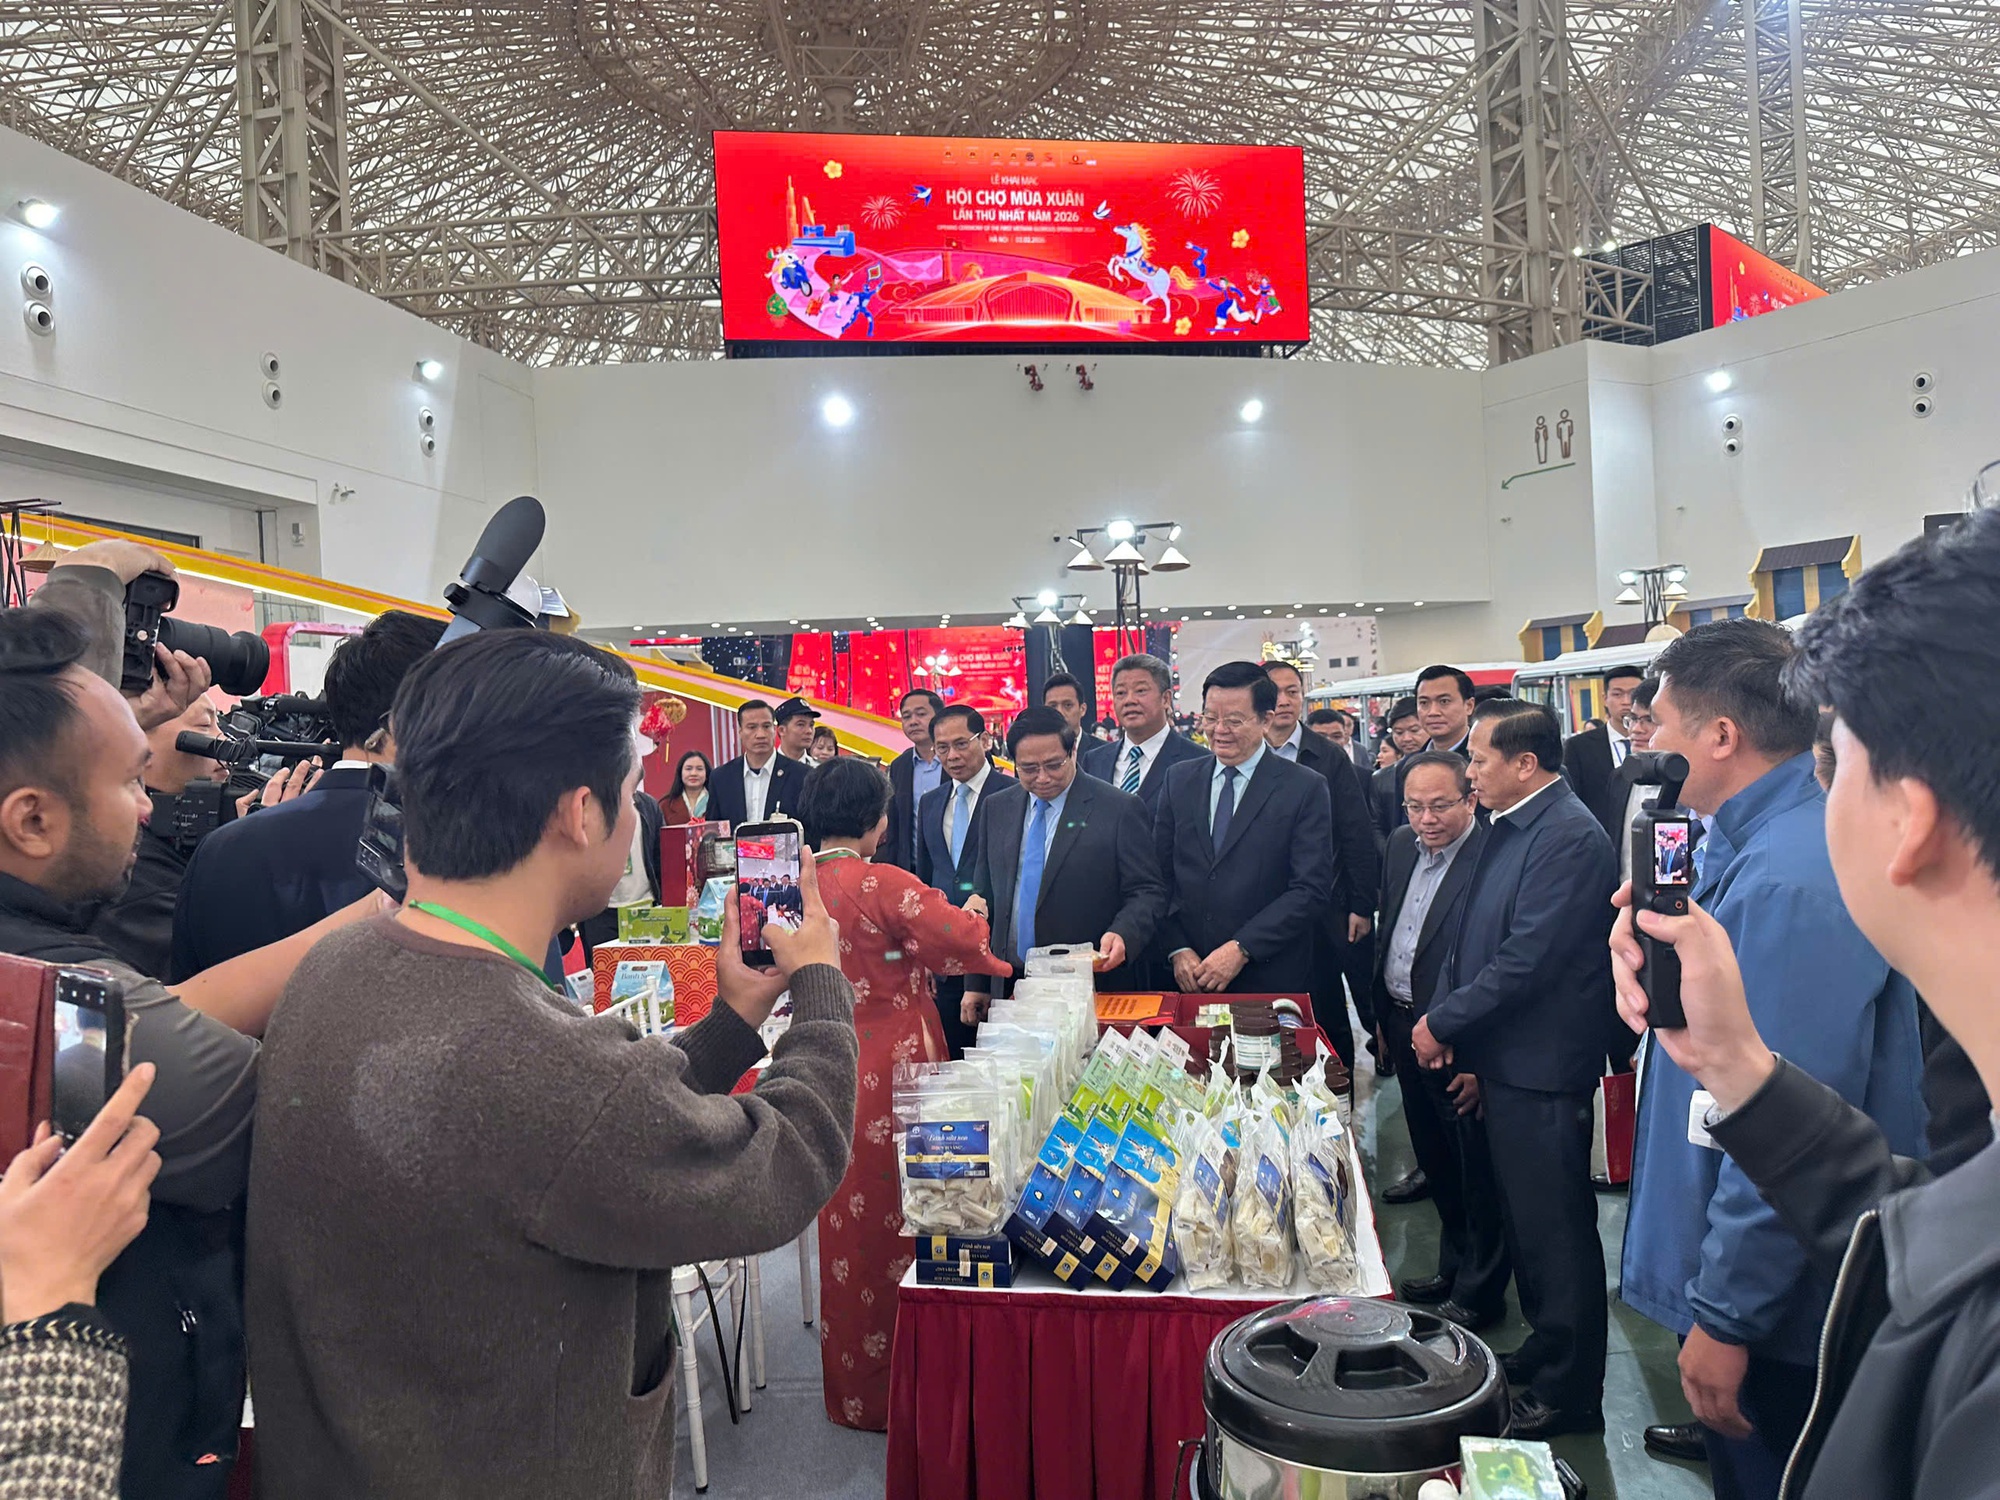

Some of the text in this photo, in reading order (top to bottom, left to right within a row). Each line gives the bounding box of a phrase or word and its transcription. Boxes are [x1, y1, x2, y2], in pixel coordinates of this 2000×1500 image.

[1001, 175, 1020, 186] KHAI
[946, 187, 1085, 208] HỘI CHỢ MÙA XUÂN
[953, 207, 973, 221] LẦN
[998, 207, 1025, 222] NHẤT
[1053, 211, 1079, 222] 2026
